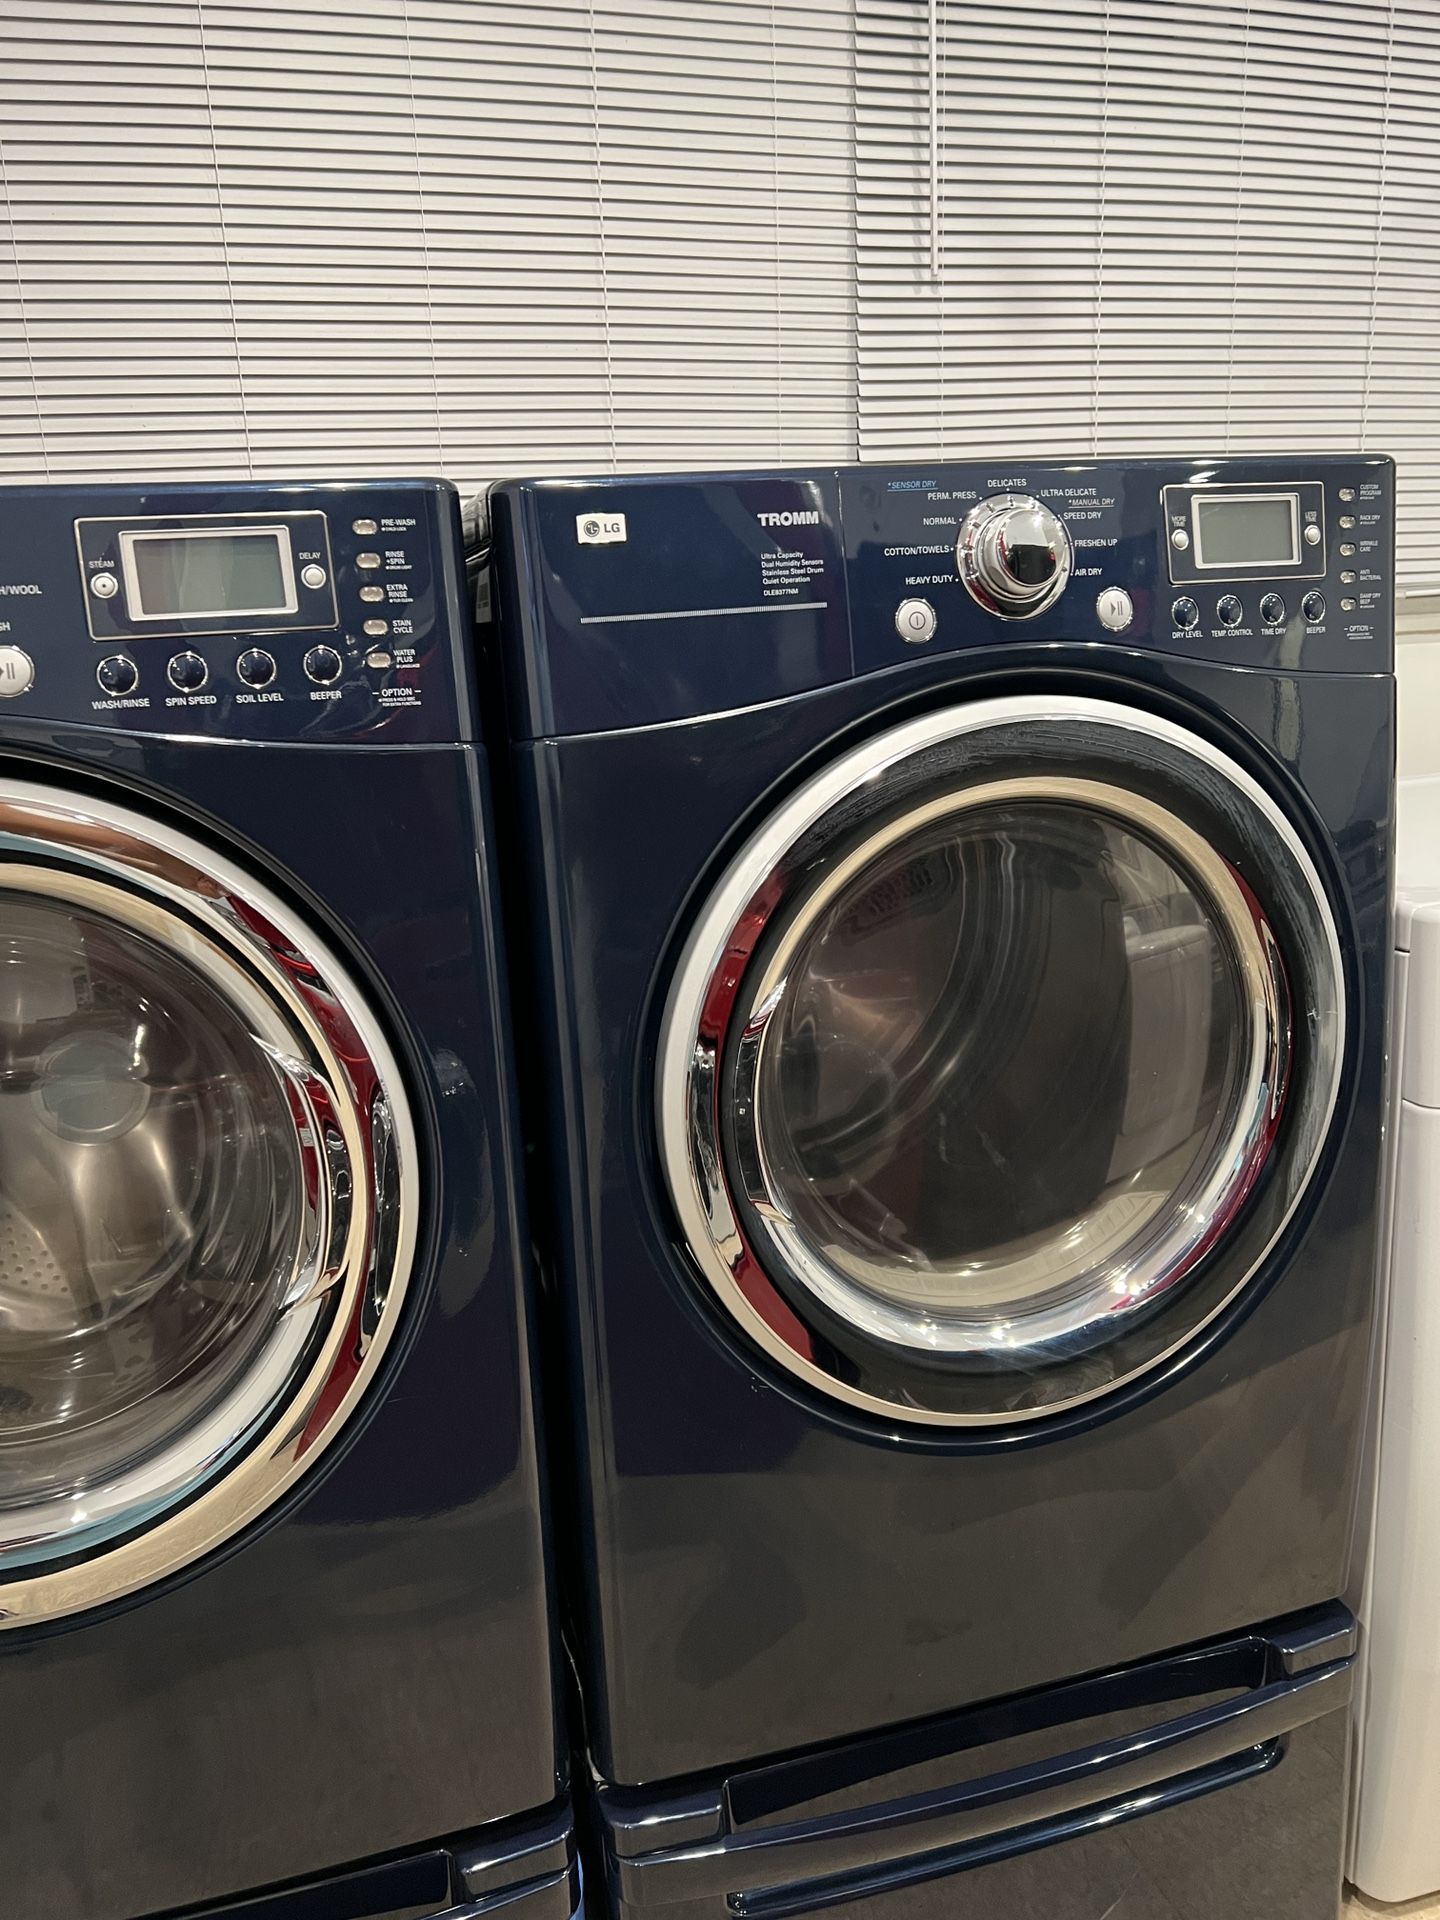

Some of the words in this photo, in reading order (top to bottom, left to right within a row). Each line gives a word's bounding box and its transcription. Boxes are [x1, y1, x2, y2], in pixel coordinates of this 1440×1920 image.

[892, 481, 920, 489] SENSOR
[922, 480, 937, 488] DRY
[987, 479, 1027, 488] DELICATES
[927, 492, 951, 501] PERM.
[953, 491, 977, 499] PRESS
[1040, 488, 1064, 497] ULTRA
[1064, 488, 1097, 496] DELICATE
[757, 511, 819, 526] TROMM
[1063, 511, 1087, 520] SPEED
[1087, 511, 1102, 519] DRY
[381, 518, 417, 526] PRE-WASH
[922, 517, 957, 526] NORMAL
[603, 522, 621, 534] LG
[1074, 538, 1106, 547] FRESHEN
[1107, 538, 1118, 546] UP
[384, 550, 405, 558] RINSE
[883, 544, 950, 557] COTTON/TOWELS
[299, 551, 321, 560] DELAY
[777, 552, 803, 560] Capacity
[89, 560, 115, 569] STEAM
[775, 559, 801, 569] Humidity
[790, 567, 806, 575] Steel
[1074, 569, 1087, 577] AIR
[1087, 568, 1103, 577] DRY
[762, 577, 779, 585] Quiet
[780, 575, 811, 584] Operation
[905, 576, 932, 586] HEAVY
[931, 575, 954, 584] DUTY
[386, 583, 408, 591] EXTRA
[393, 626, 414, 634] CYCLE
[1171, 631, 1186, 639] DRY
[1185, 630, 1204, 638] LEVEL
[1227, 628, 1254, 637] CONTROL
[1260, 628, 1274, 636] TIME
[1306, 626, 1327, 634] BEEPER
[393, 648, 416, 656] WATER
[310, 690, 342, 701] BEEPER
[381, 688, 413, 697] OPTION
[165, 697, 188, 707] SPIN
[187, 695, 217, 704] SPEED
[235, 694, 257, 704] SOIL
[257, 692, 284, 703] LEVEL
[92, 699, 150, 709] WASH/RINSE
